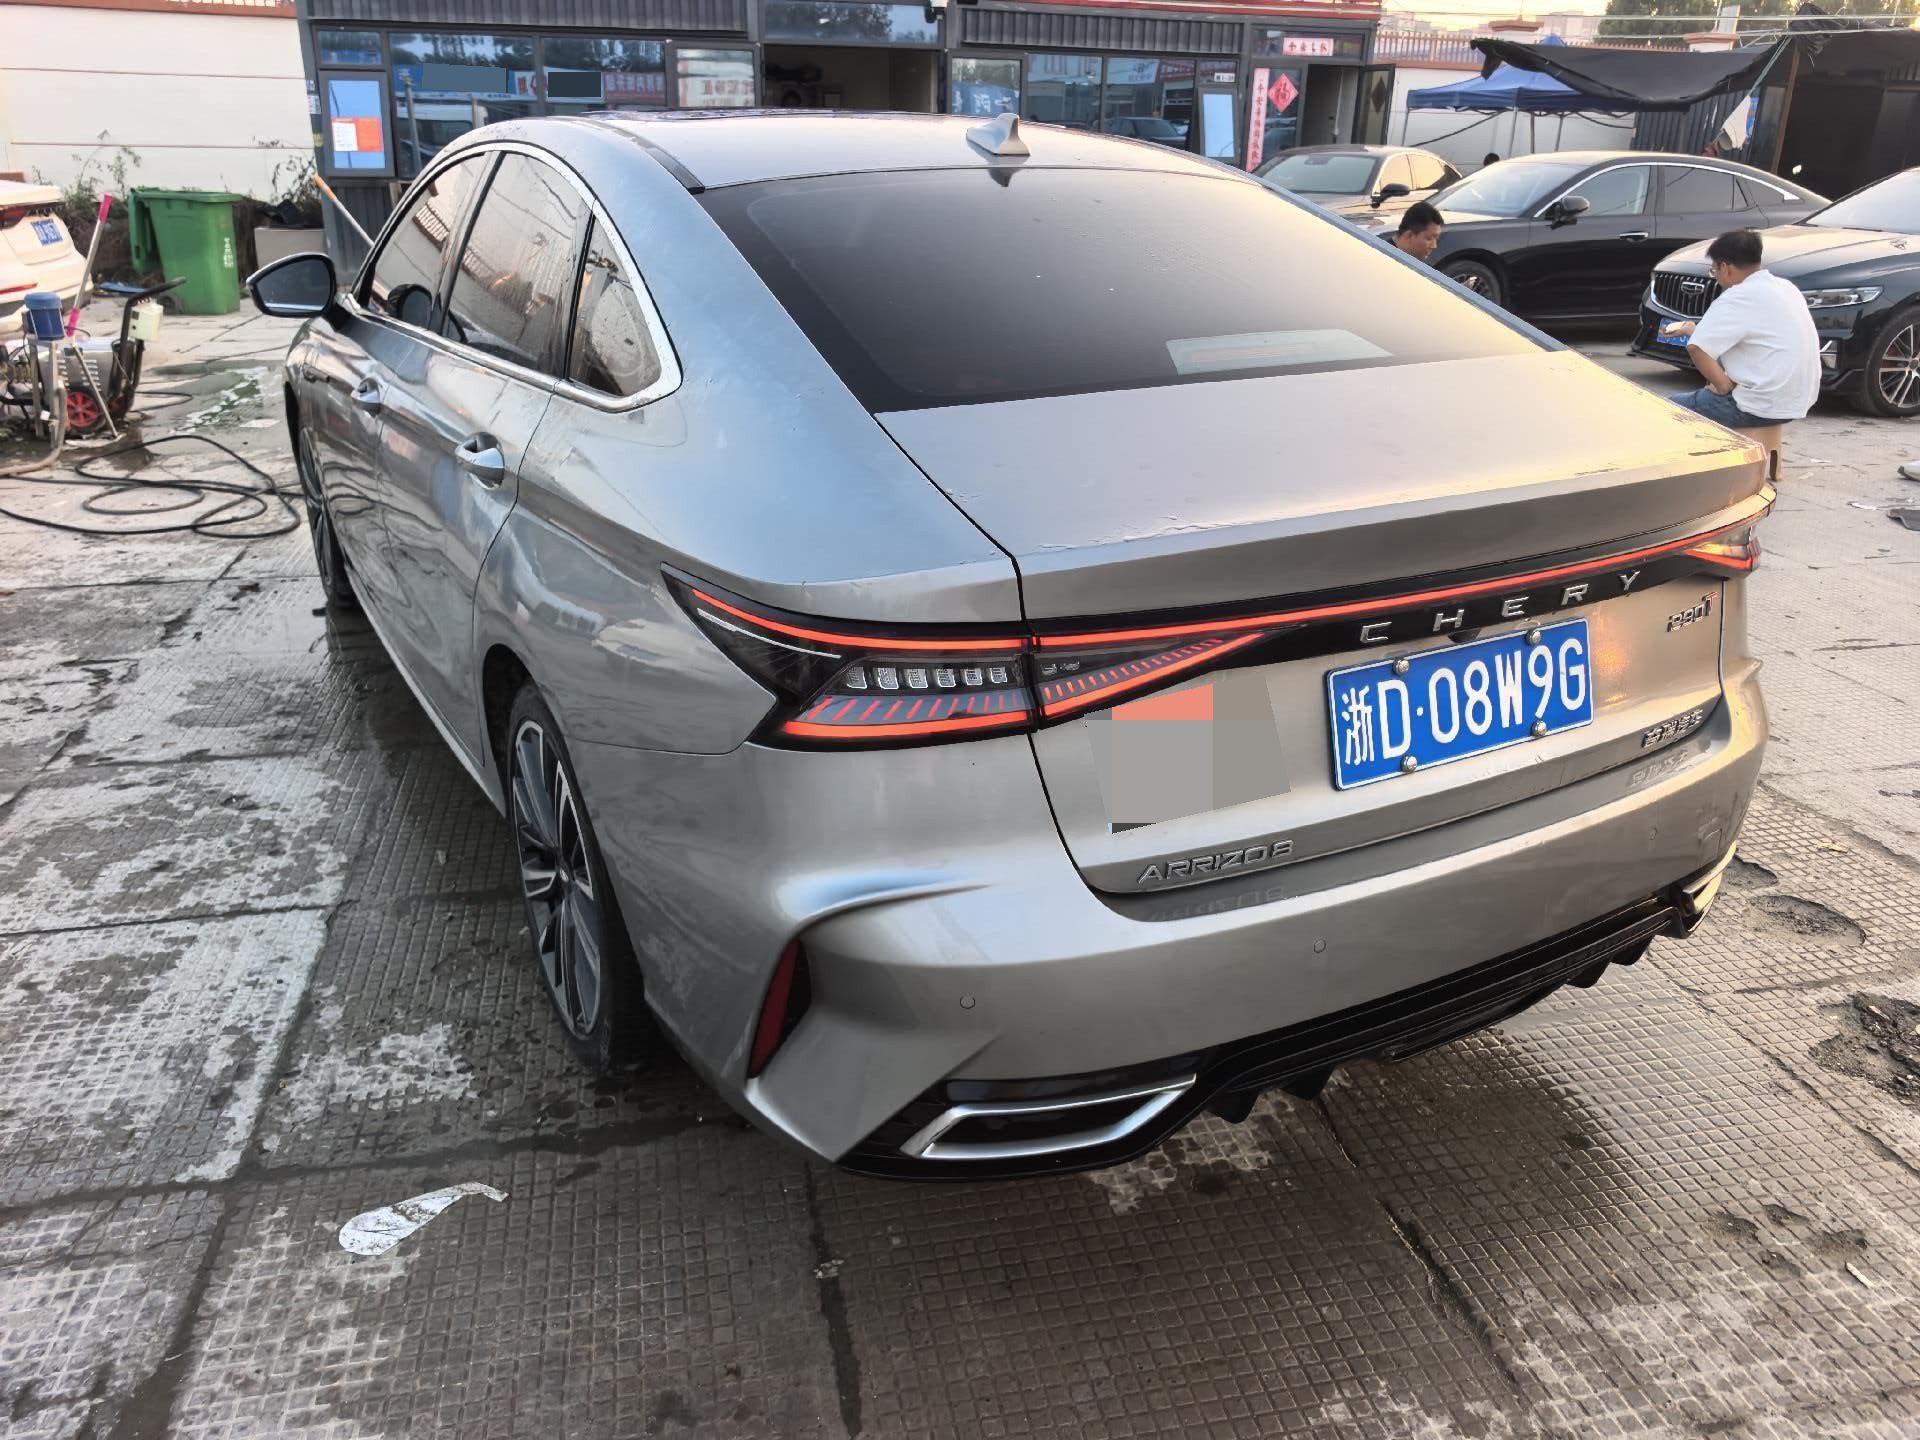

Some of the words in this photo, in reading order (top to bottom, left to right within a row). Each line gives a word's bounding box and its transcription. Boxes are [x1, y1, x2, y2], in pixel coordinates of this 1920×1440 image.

[1360, 571, 1641, 644] CHERY
[1137, 846, 1268, 885] ARRIZO
[1271, 839, 1295, 859] 8
